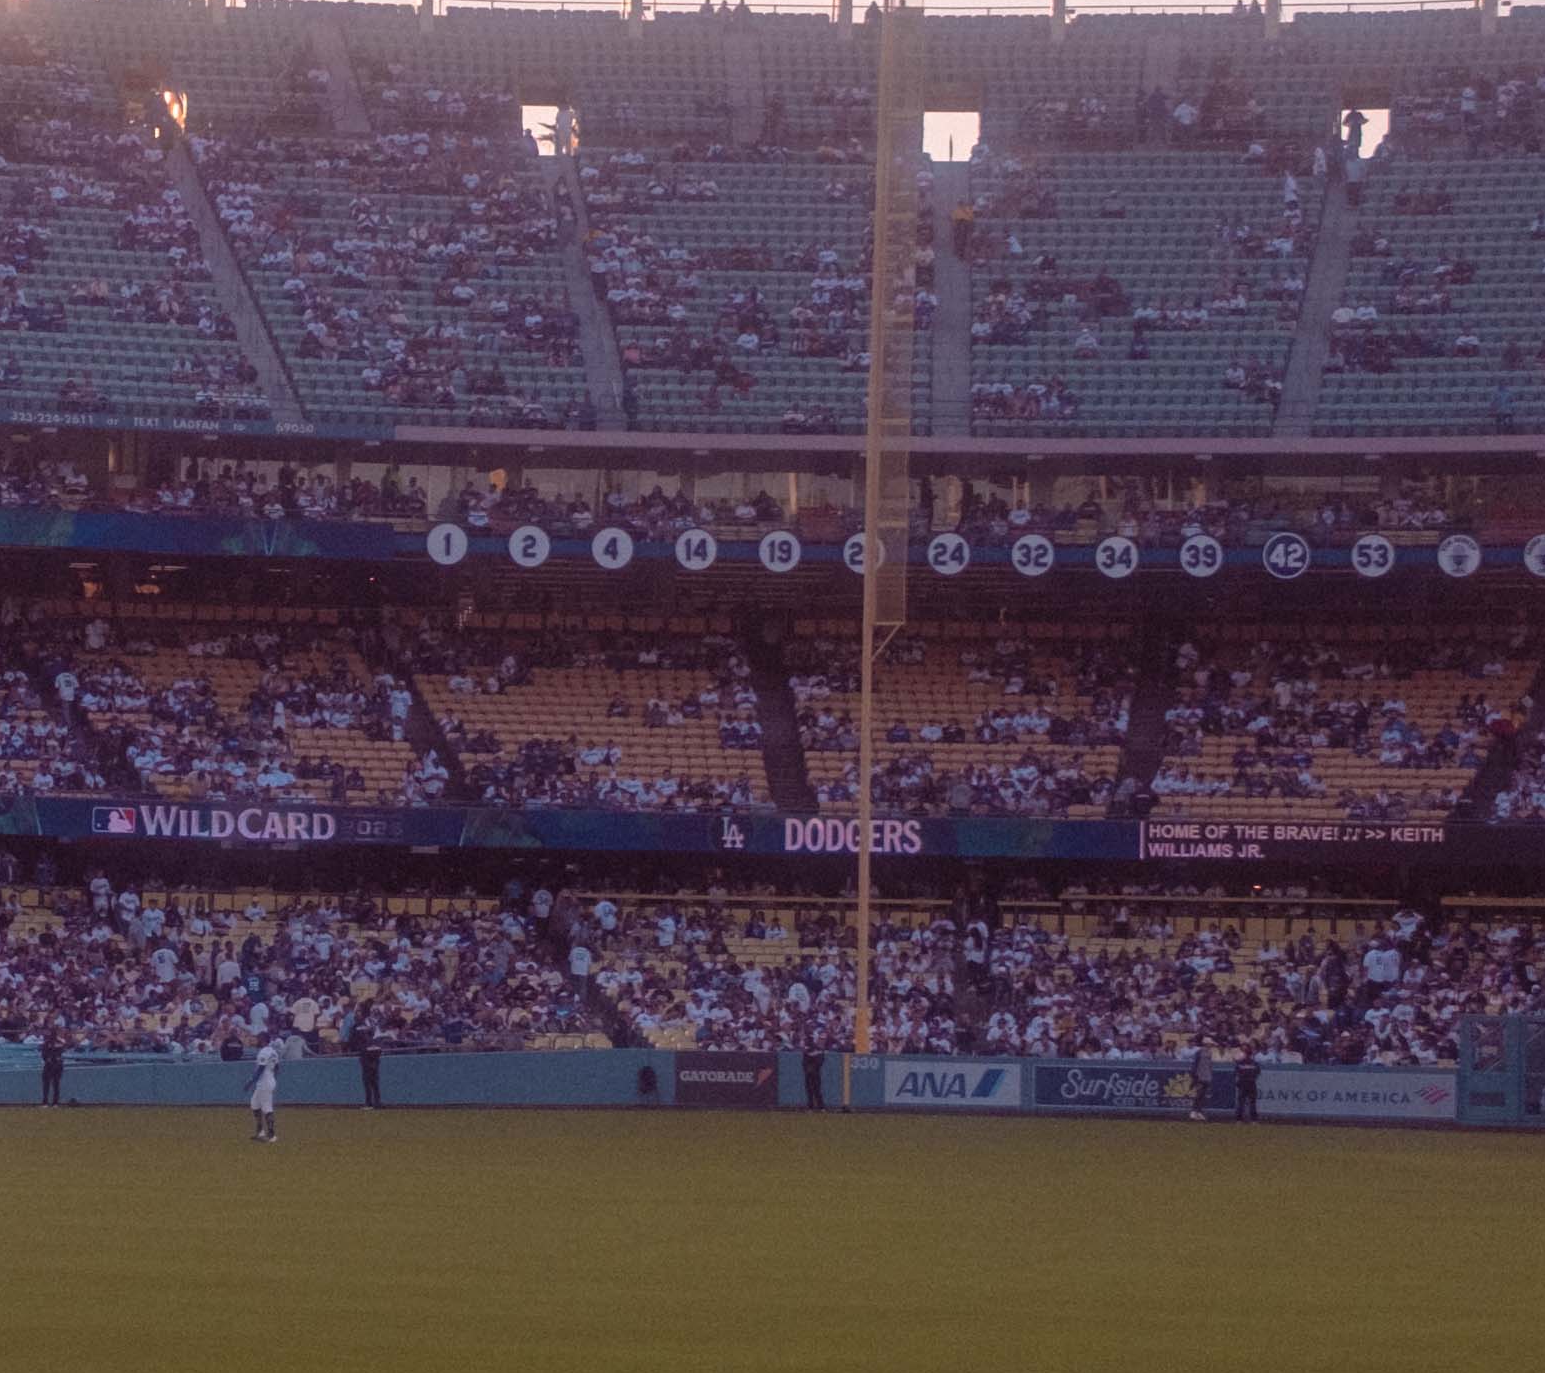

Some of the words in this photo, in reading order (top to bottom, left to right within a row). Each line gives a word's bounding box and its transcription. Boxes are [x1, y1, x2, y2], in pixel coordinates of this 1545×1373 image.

[133, 417, 160, 428] TEXT
[442, 532, 452, 557] 1
[521, 535, 537, 559] 2
[603, 537, 619, 561] 4
[684, 538, 708, 562] 14
[767, 540, 793, 564] 19
[848, 542, 866, 566] 2
[931, 541, 966, 566] 24
[1016, 543, 1049, 568] 32
[1184, 544, 1219, 568] 39
[1269, 542, 1306, 569] 42
[1355, 543, 1389, 568] 53
[1100, 545, 1133, 570] 34
[784, 817, 923, 854] DODGERS
[1148, 824, 1201, 840] HOME
[1205, 825, 1227, 840] OF
[1234, 826, 1268, 841] THE
[1273, 826, 1340, 842] BRAVE!
[1390, 827, 1445, 843] KEITH
[1148, 842, 1234, 859] WILLIAMS
[1237, 843, 1267, 859] JR.
[850, 1057, 880, 1071] 330
[678, 1070, 756, 1084] GATORADE
[894, 1070, 967, 1099] ANA
[1058, 1068, 1160, 1100] Surfside
[1307, 1089, 1329, 1103] OF
[1332, 1090, 1412, 1106] AMERICA
